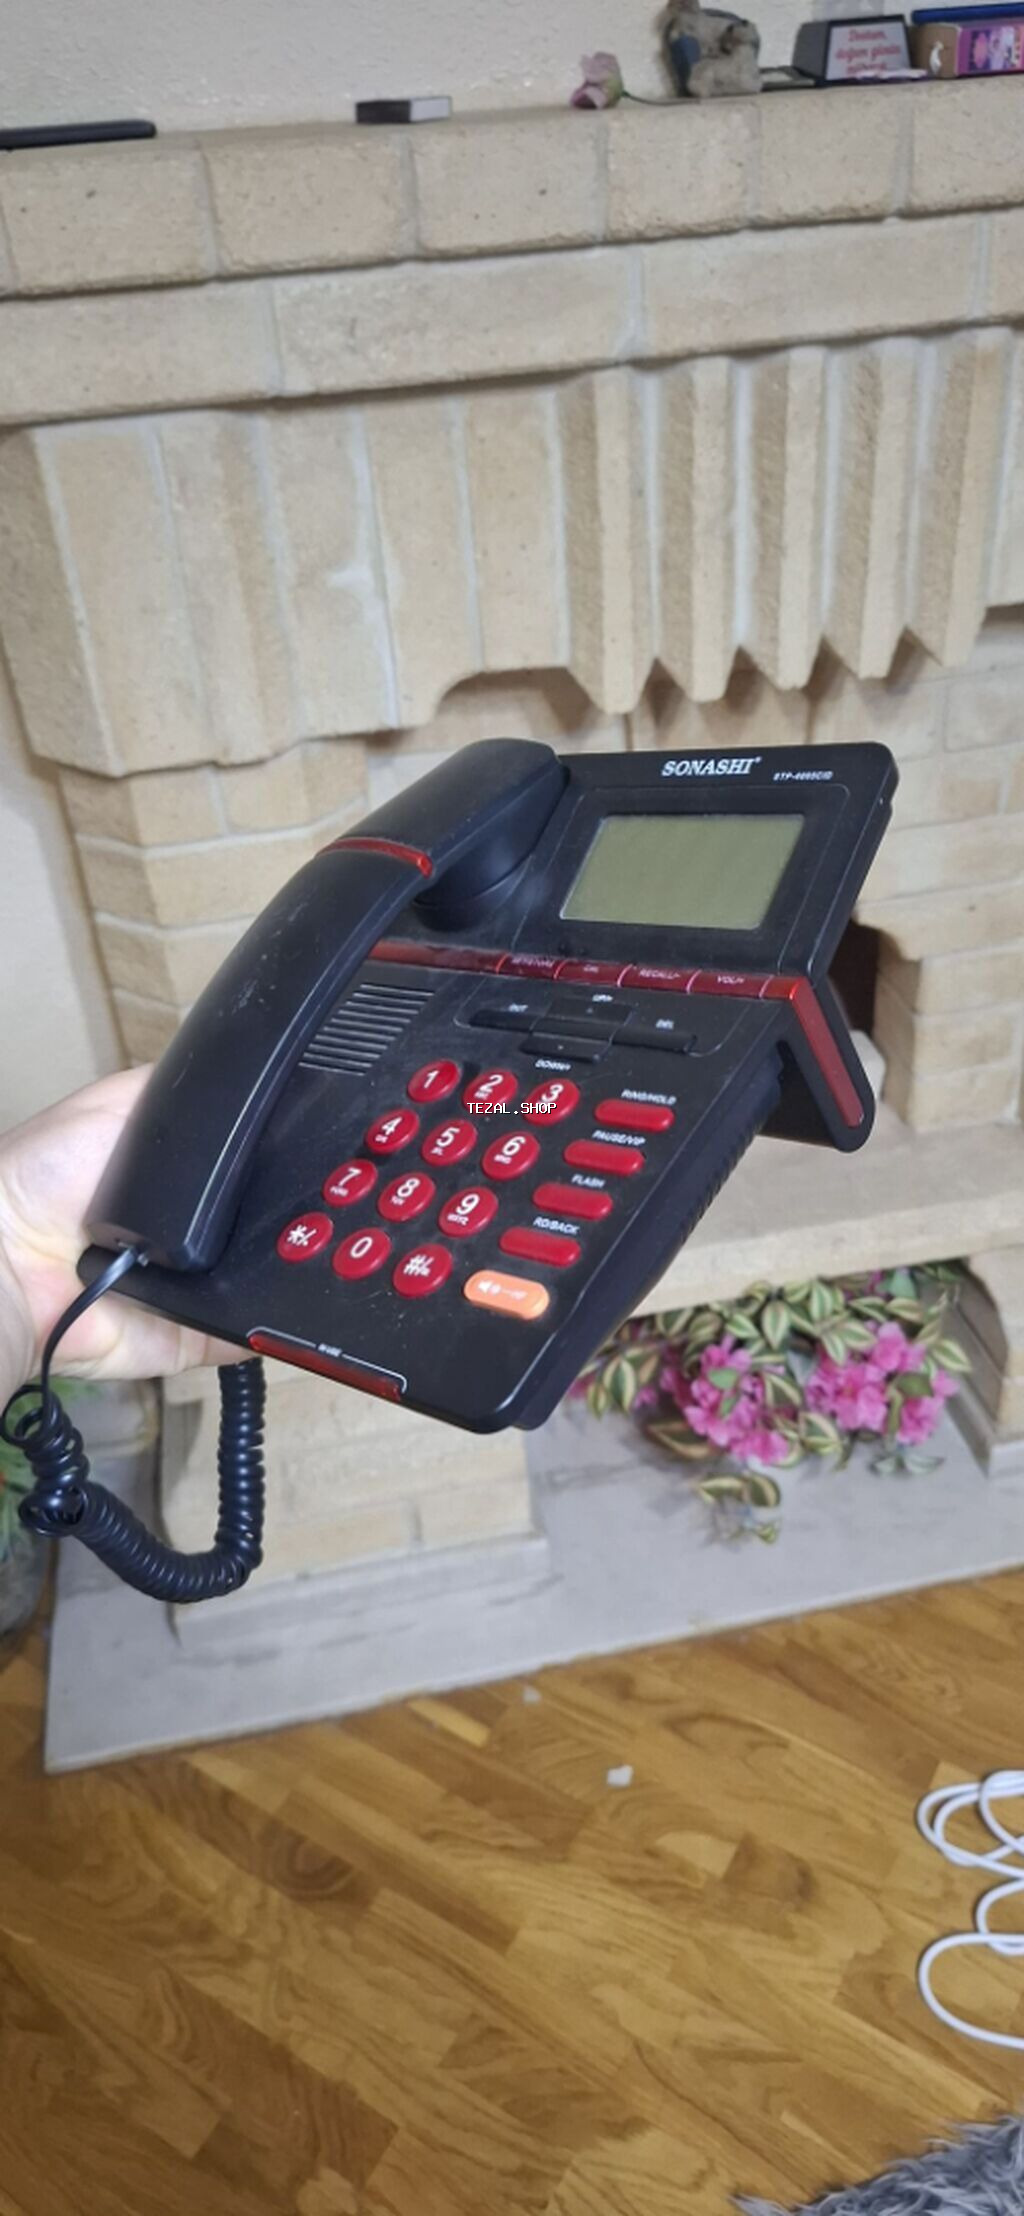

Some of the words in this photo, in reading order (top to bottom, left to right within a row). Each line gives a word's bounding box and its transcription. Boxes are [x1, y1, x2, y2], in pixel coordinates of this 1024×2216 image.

[661, 757, 756, 777] SONASHI
[423, 1070, 440, 1089] 1
[479, 1074, 504, 1093] 2
[541, 1084, 565, 1102] 3
[381, 1116, 403, 1136] 4
[436, 1127, 460, 1147] 5
[501, 1135, 526, 1156] 6
[338, 1166, 363, 1187] 7
[571, 1173, 606, 1188] FLASH
[396, 1177, 421, 1198] 8
[455, 1193, 481, 1216] 9
[349, 1236, 373, 1259] 0
